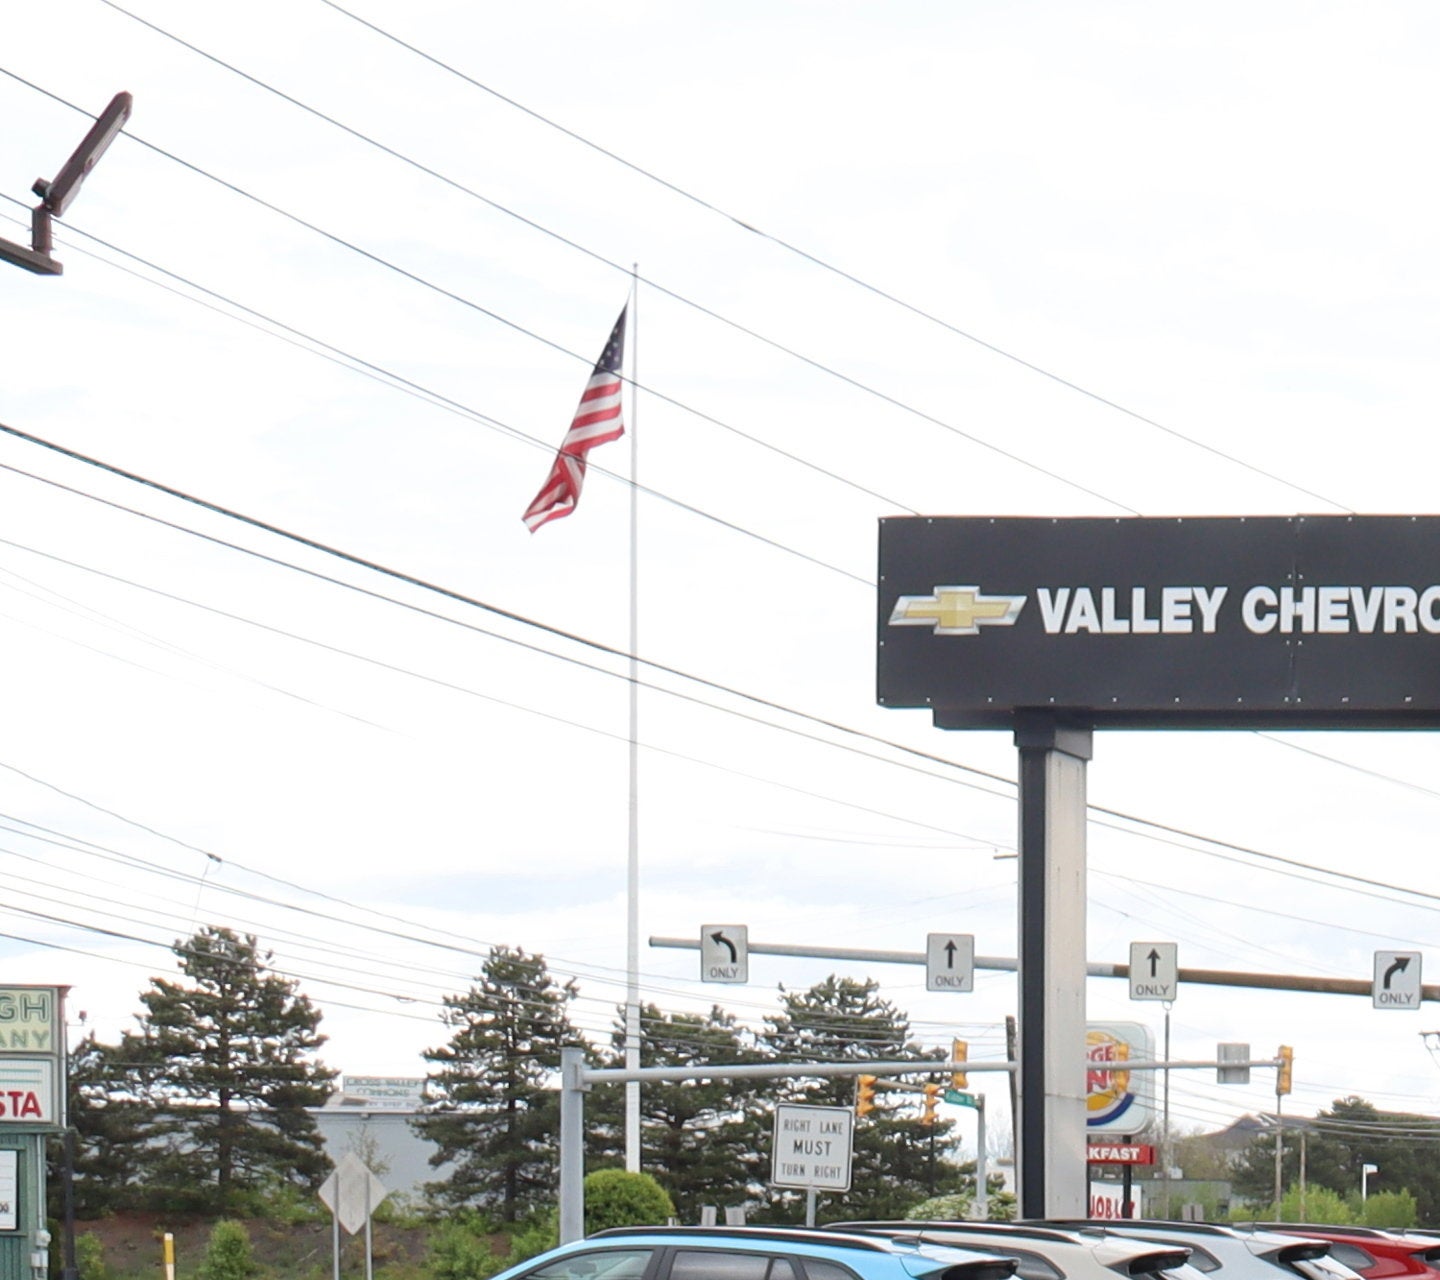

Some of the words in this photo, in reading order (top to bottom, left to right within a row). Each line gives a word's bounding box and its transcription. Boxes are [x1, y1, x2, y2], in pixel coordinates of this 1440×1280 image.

[1037, 587, 1228, 634] VALLEY
[710, 967, 739, 979] ONLY
[935, 976, 965, 988] ONLY
[1136, 984, 1170, 996] ONLY
[1380, 993, 1414, 1005] ONLY
[783, 1119, 811, 1133] RIGHT
[819, 1121, 844, 1135] LANE
[793, 1139, 832, 1156] MUST
[1087, 1147, 1140, 1161] KFAST
[781, 1163, 806, 1177] TURN
[814, 1165, 842, 1179] RIGHT
